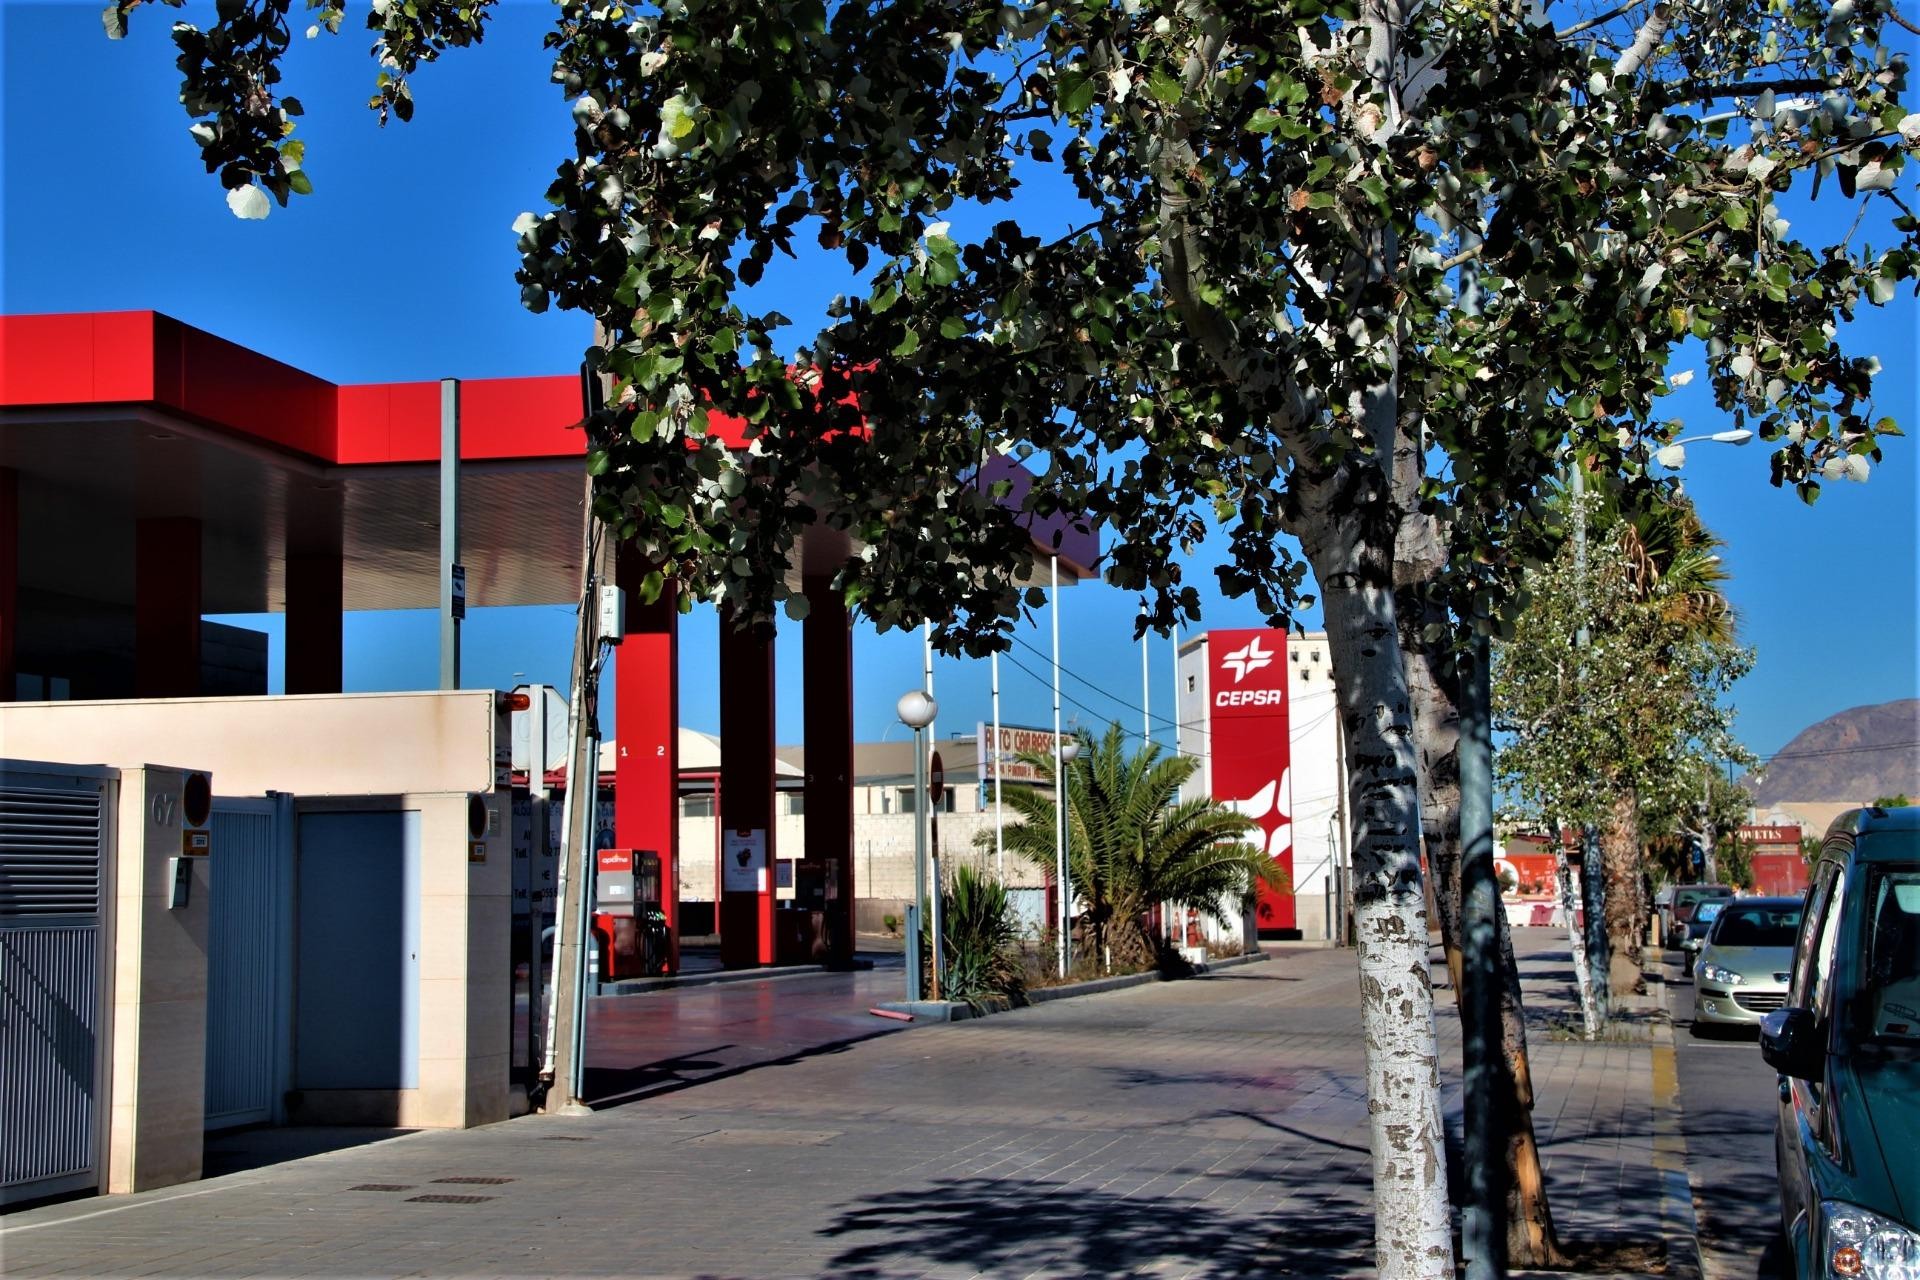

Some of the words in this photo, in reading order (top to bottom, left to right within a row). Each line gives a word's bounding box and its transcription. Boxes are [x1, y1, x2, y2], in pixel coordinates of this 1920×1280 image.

[1215, 689, 1281, 707] CEPSA
[621, 746, 629, 757] 1
[657, 745, 665, 756] 2
[808, 773, 814, 783] 3
[837, 773, 844, 783] 4
[152, 792, 175, 826] 67
